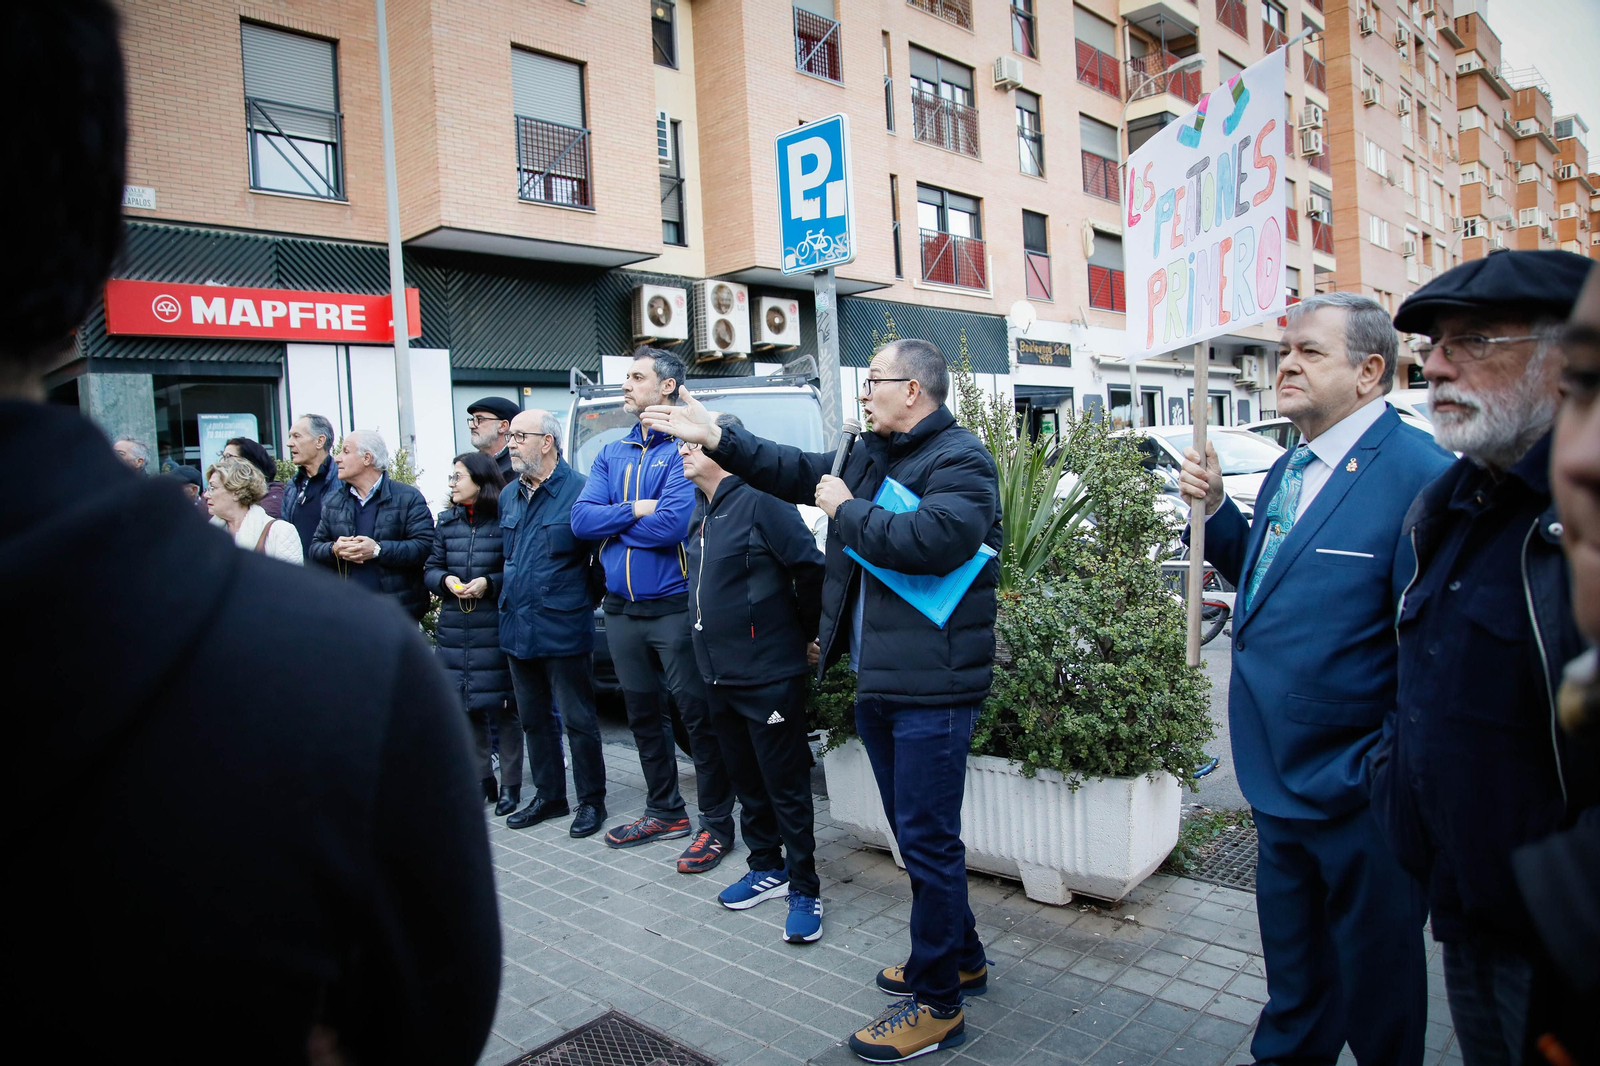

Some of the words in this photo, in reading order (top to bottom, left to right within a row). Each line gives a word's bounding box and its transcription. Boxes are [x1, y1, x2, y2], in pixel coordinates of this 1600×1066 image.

[122, 197, 152, 208] LAPALOS
[786, 136, 832, 220] P
[1127, 161, 1156, 228] LOS
[1153, 118, 1277, 259] PEATONES
[190, 295, 367, 331] MAPFRE
